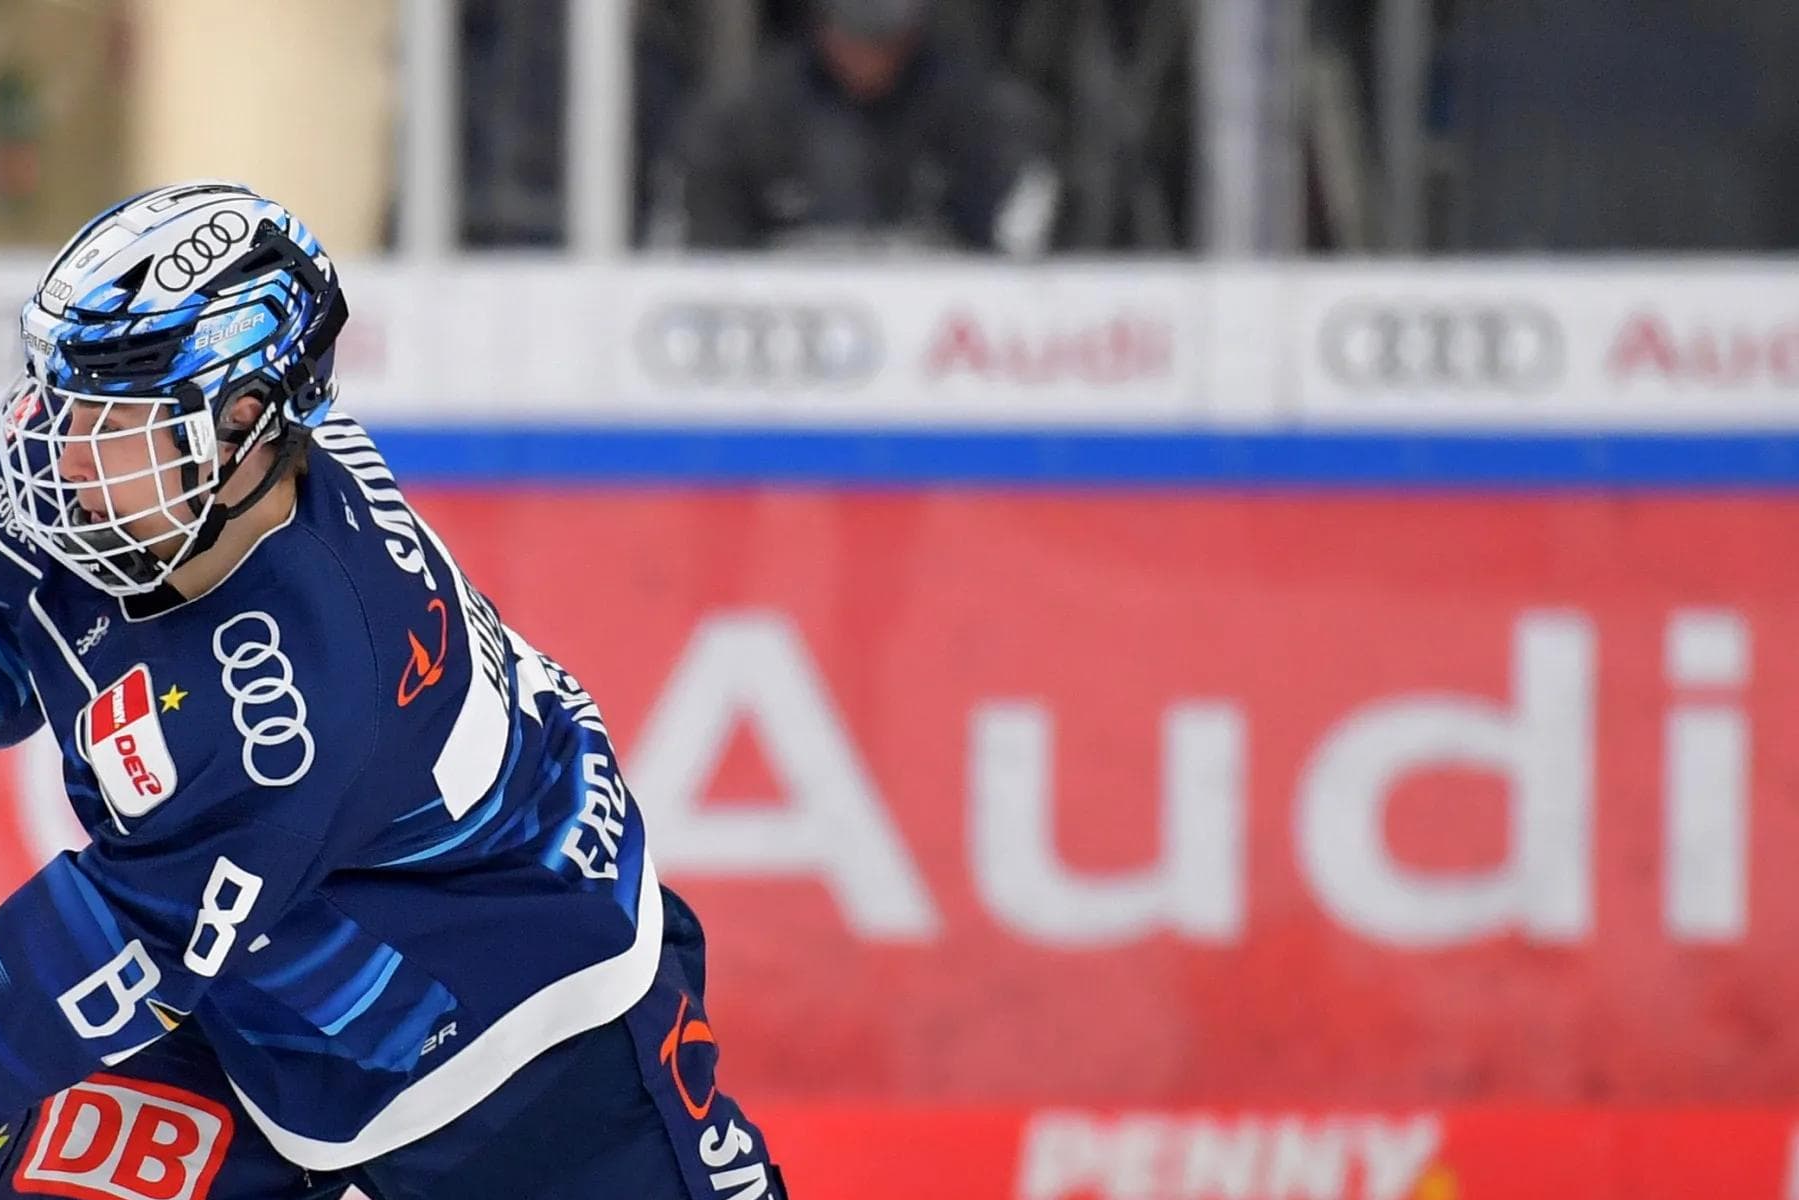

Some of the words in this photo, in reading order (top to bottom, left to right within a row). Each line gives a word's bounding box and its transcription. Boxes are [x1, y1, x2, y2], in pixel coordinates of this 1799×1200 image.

[922, 308, 1174, 384] Audi
[622, 607, 1754, 946] Audi
[37, 1088, 201, 1200] DB
